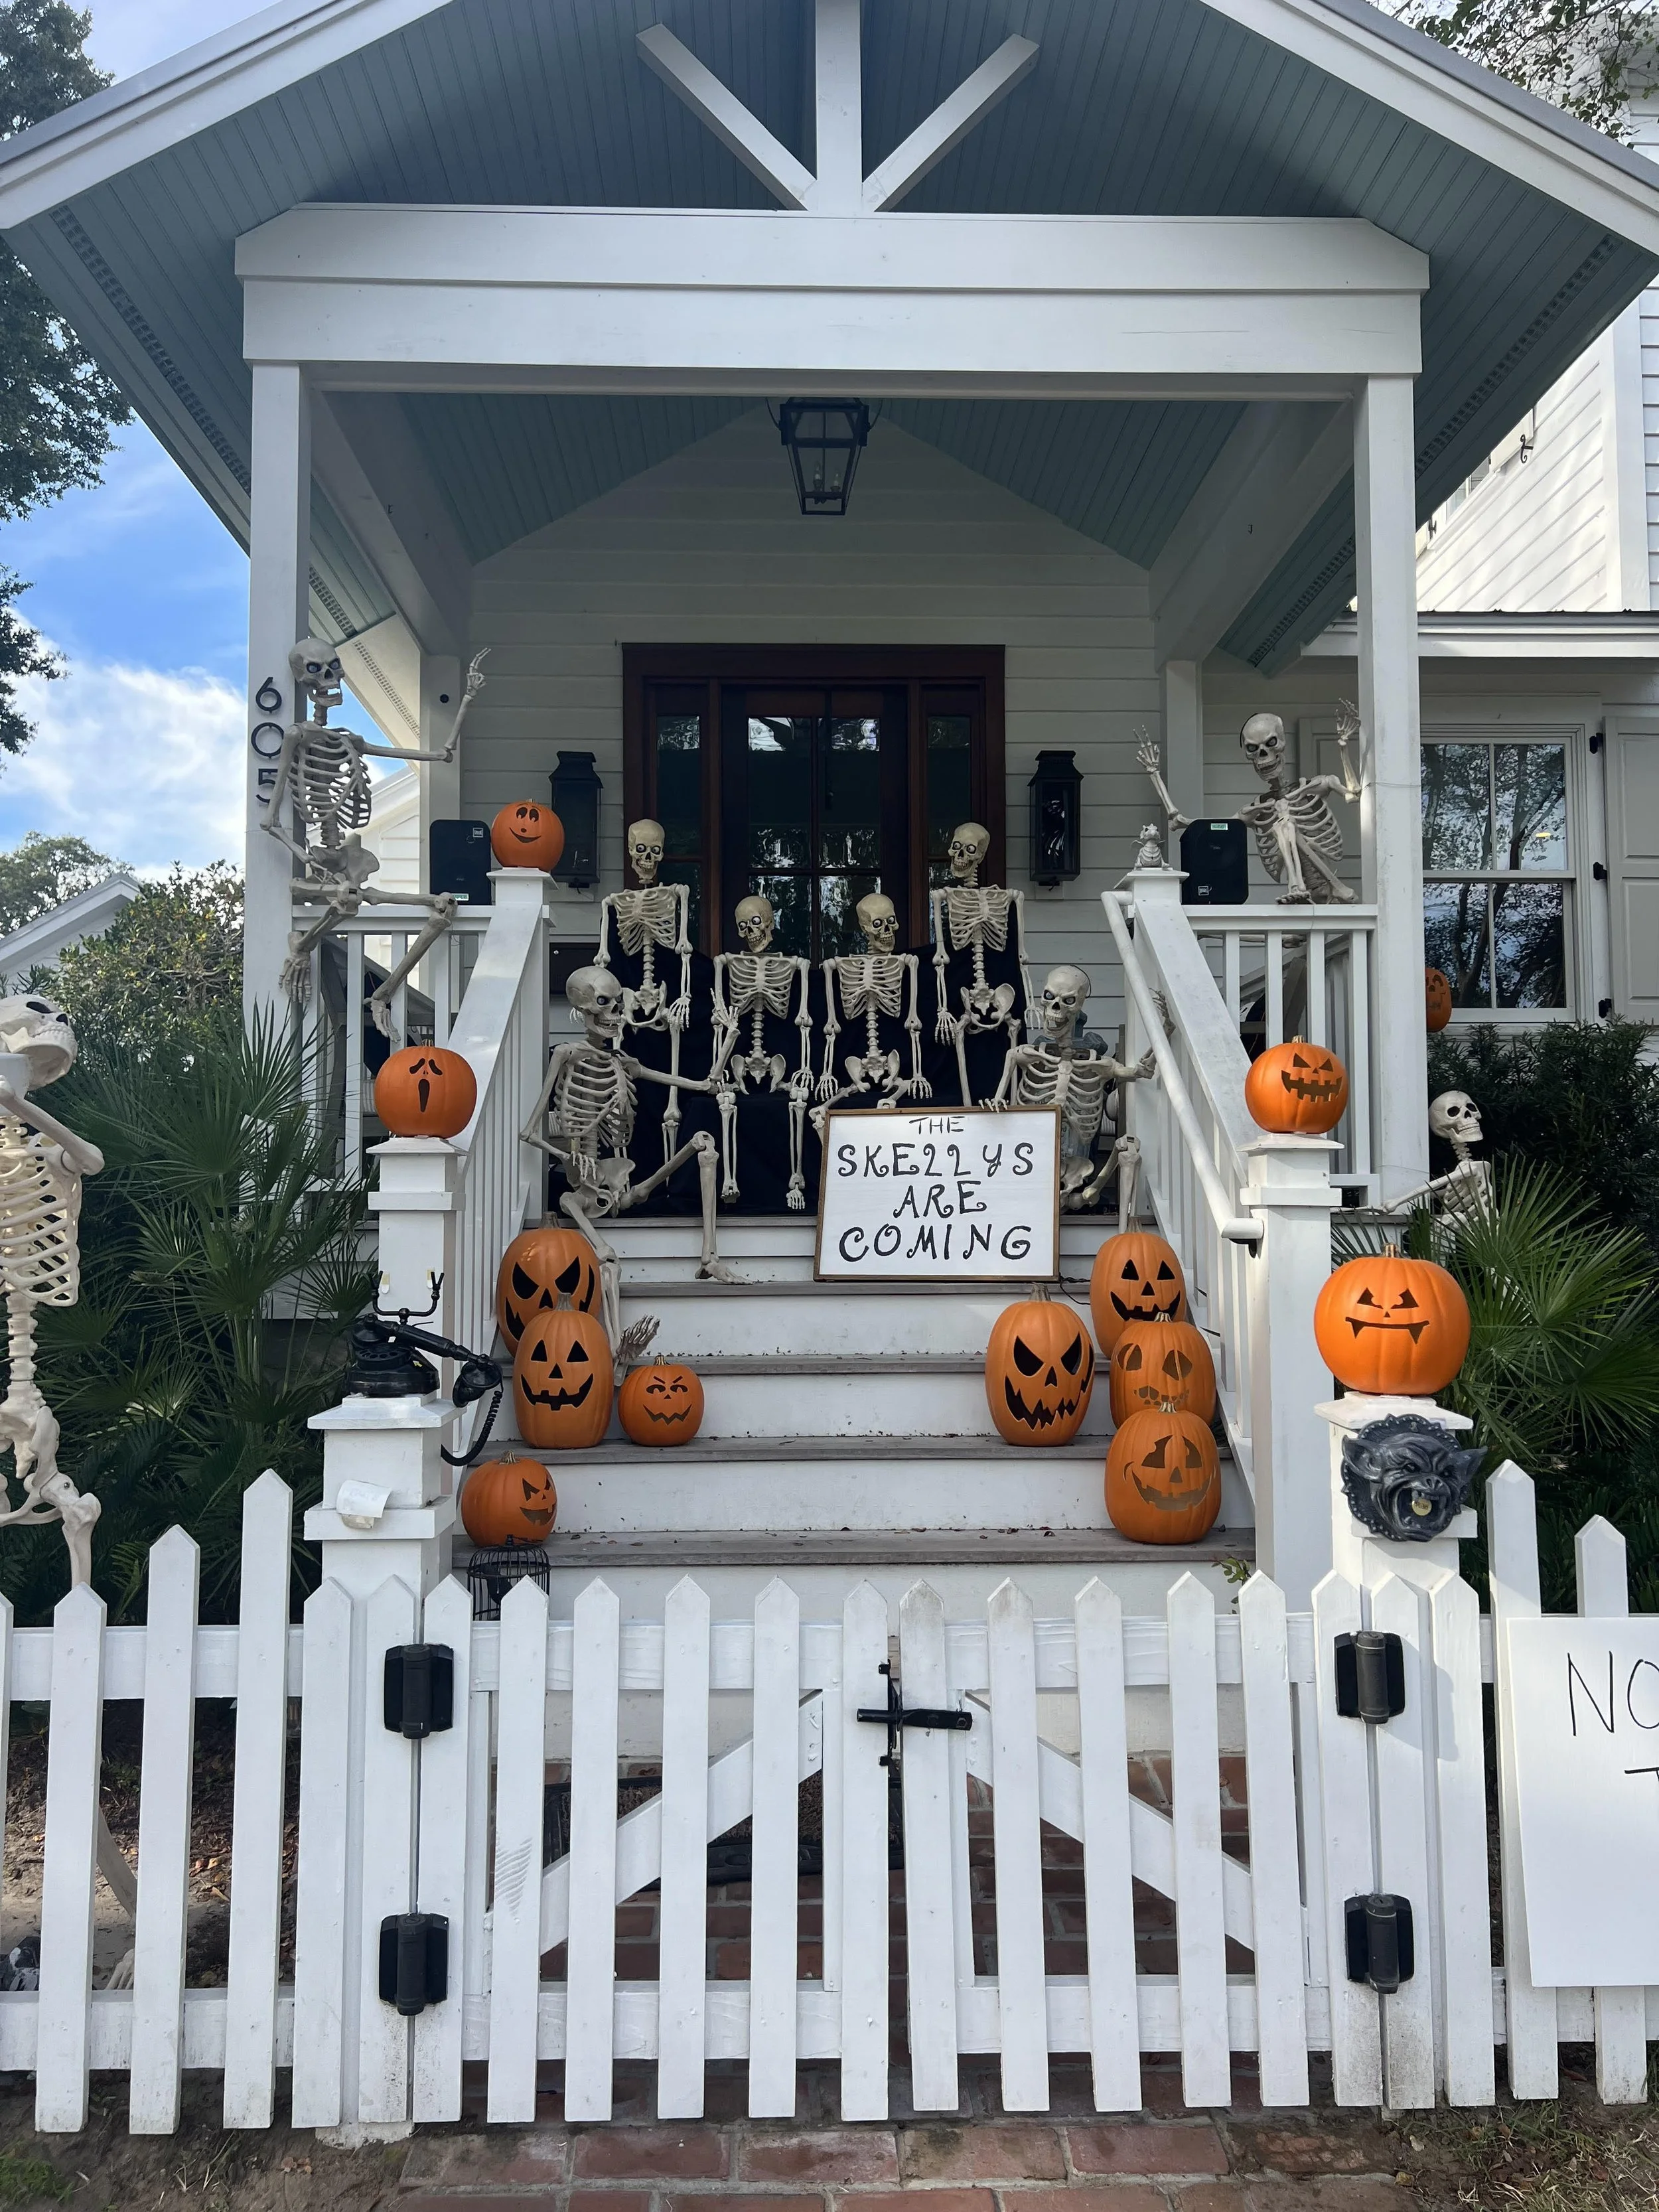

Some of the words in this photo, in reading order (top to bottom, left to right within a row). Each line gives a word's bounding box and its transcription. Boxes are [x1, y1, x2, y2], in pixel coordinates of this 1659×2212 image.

[251, 676, 285, 804] 605
[909, 1116, 965, 1134] THE
[893, 1180, 987, 1218] ARE
[839, 1223, 1032, 1262] COMING
